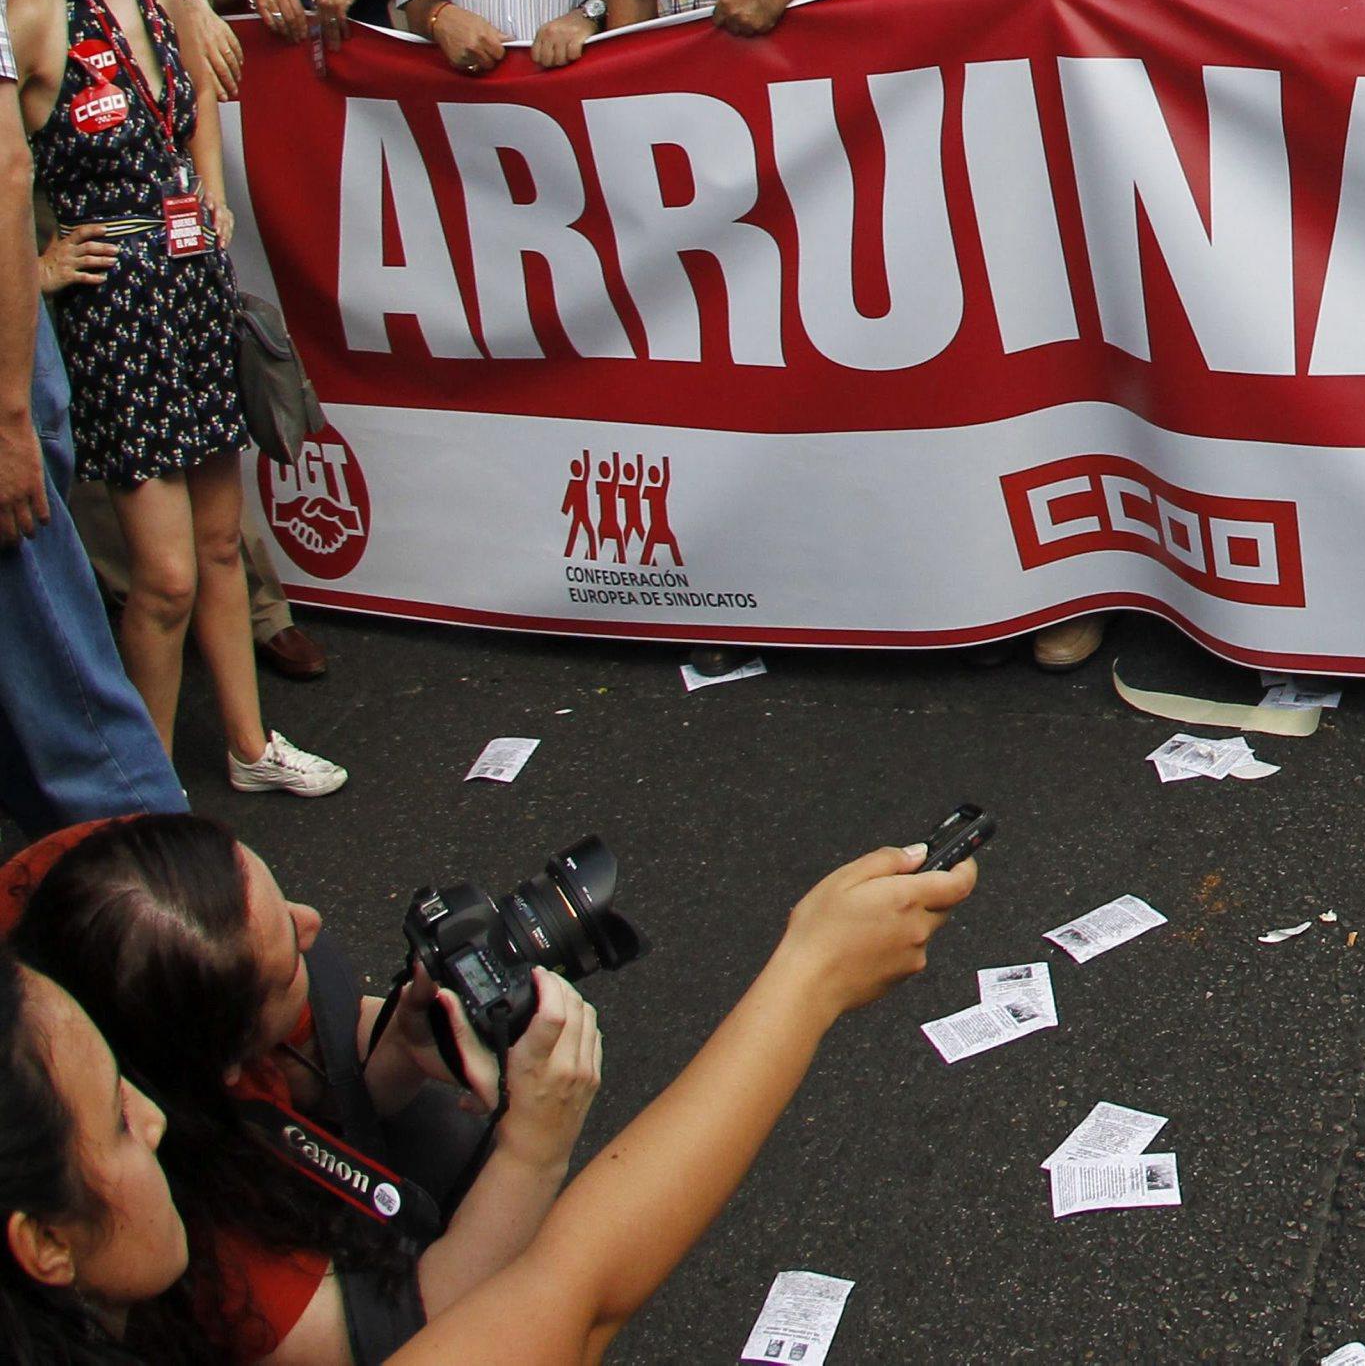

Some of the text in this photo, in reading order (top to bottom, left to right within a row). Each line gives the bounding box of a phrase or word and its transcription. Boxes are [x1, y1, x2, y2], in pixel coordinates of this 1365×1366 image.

[74, 94, 127, 123] CCOO
[1026, 474, 1281, 586] CCOO
[566, 565, 690, 588] CONFEDERACIÓN
[569, 587, 758, 609] EUROPEA DE SINDICATOS
[283, 1125, 370, 1195] Canon
